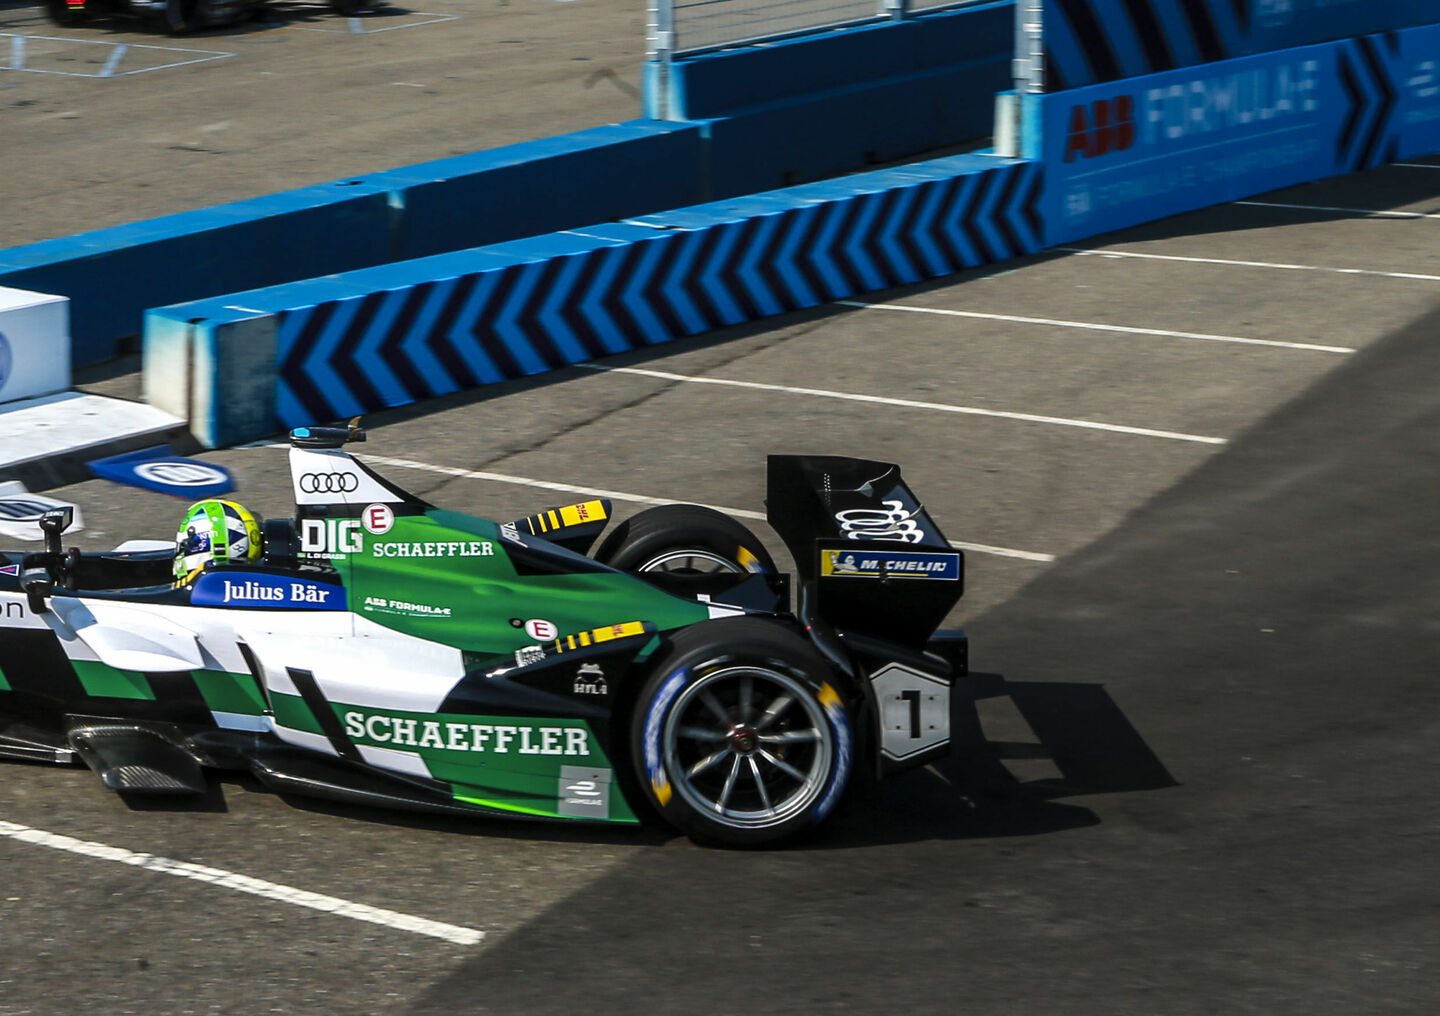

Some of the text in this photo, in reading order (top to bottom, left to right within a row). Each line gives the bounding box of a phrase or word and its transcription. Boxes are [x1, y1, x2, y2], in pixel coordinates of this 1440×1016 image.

[1064, 60, 1319, 163] ABB FORMULA-E
[370, 508, 387, 529] E
[301, 519, 363, 553] DIG
[373, 541, 495, 558] SCHAEFFLER
[860, 559, 948, 572] MCHELIN
[223, 581, 330, 603] Julius Bär
[364, 596, 388, 608] ABB
[389, 600, 452, 615] FORMULA-E
[534, 621, 551, 638] E
[344, 710, 590, 756] SCHAEFFLER
